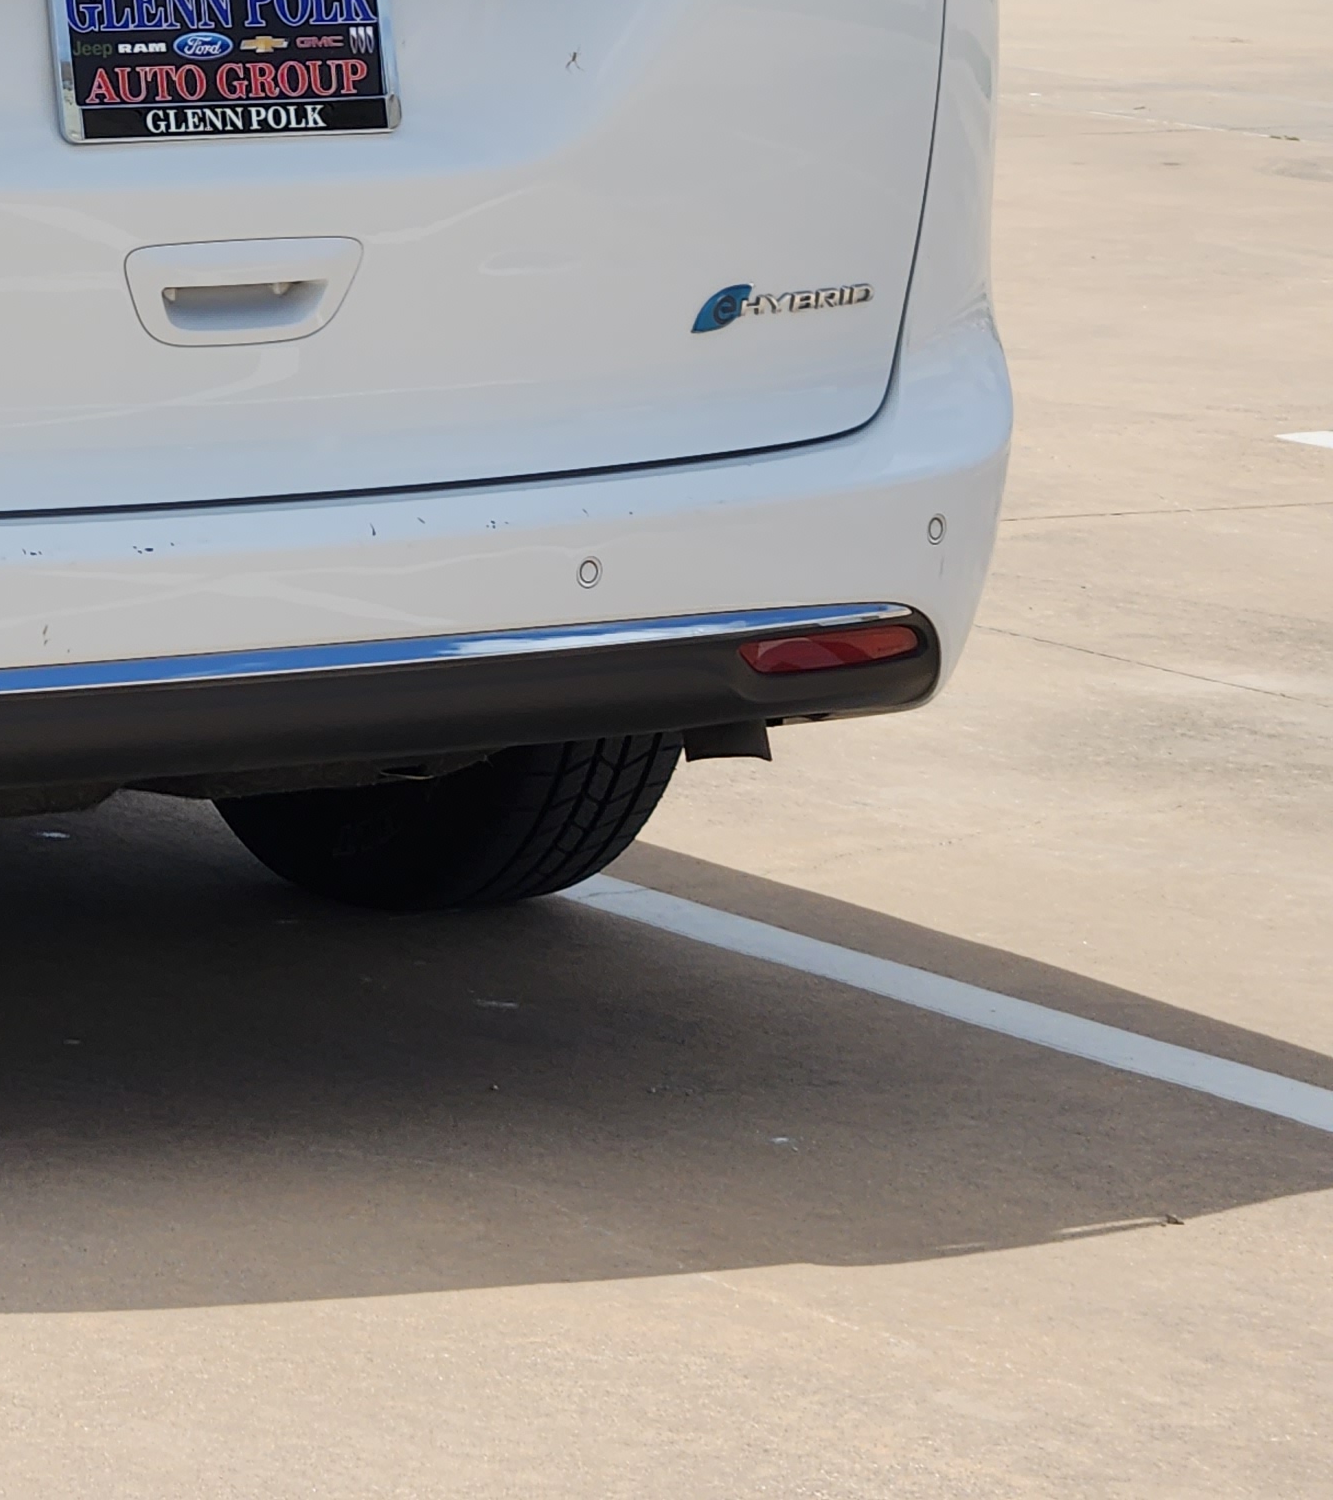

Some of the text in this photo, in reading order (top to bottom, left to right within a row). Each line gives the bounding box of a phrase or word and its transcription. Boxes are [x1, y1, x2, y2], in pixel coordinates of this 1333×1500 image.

[73, 35, 344, 60] Jeep RAM Ford GMC
[86, 59, 369, 103] AUTO GROUP
[146, 105, 328, 133] GLENN POLK
